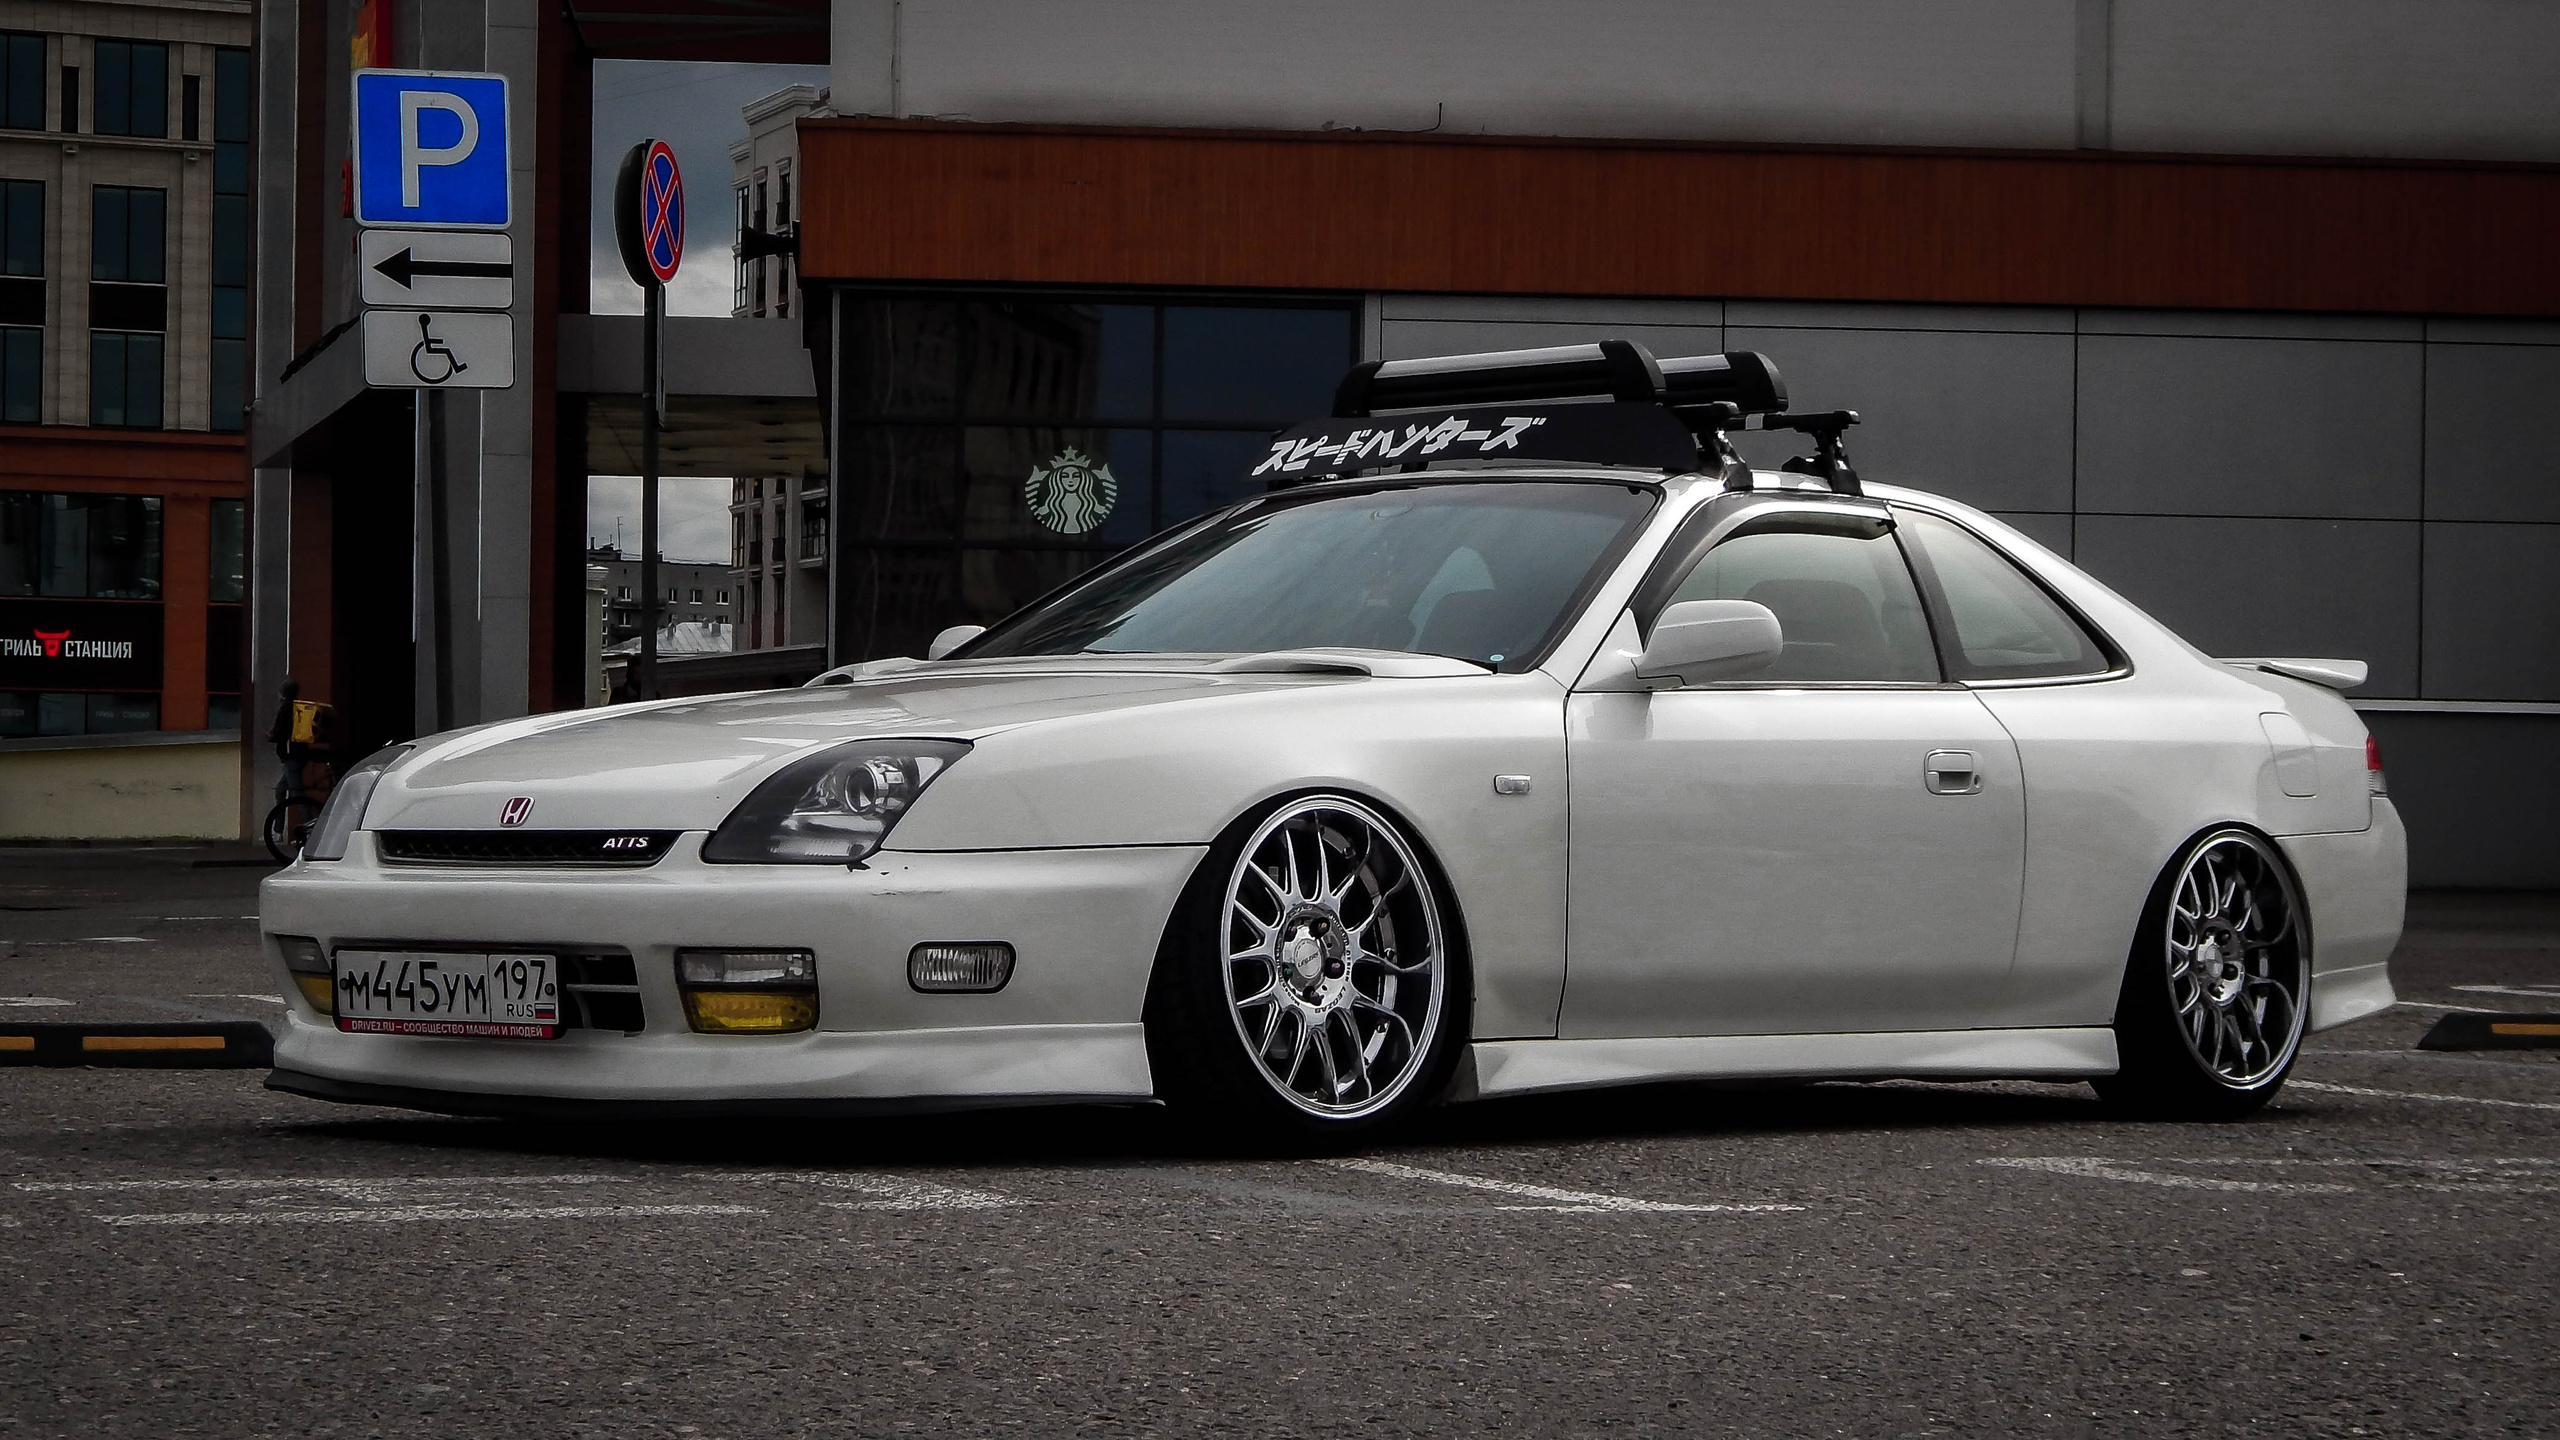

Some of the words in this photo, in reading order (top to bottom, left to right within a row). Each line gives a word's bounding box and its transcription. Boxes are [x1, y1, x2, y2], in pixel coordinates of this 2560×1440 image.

[400, 90, 479, 208] P
[65, 640, 132, 659] СТАНЦИЯ
[602, 836, 649, 849] ATTS
[494, 959, 546, 1001] 197
[506, 1003, 534, 1018] RUS
[351, 1020, 395, 1032] DRIVE2.RU
[403, 1023, 464, 1034] СООБЩЕСТВО
[466, 1025, 500, 1035] МАШИН
[501, 1026, 508, 1036] И
[510, 1025, 543, 1038] ЛЮДЕЙ
